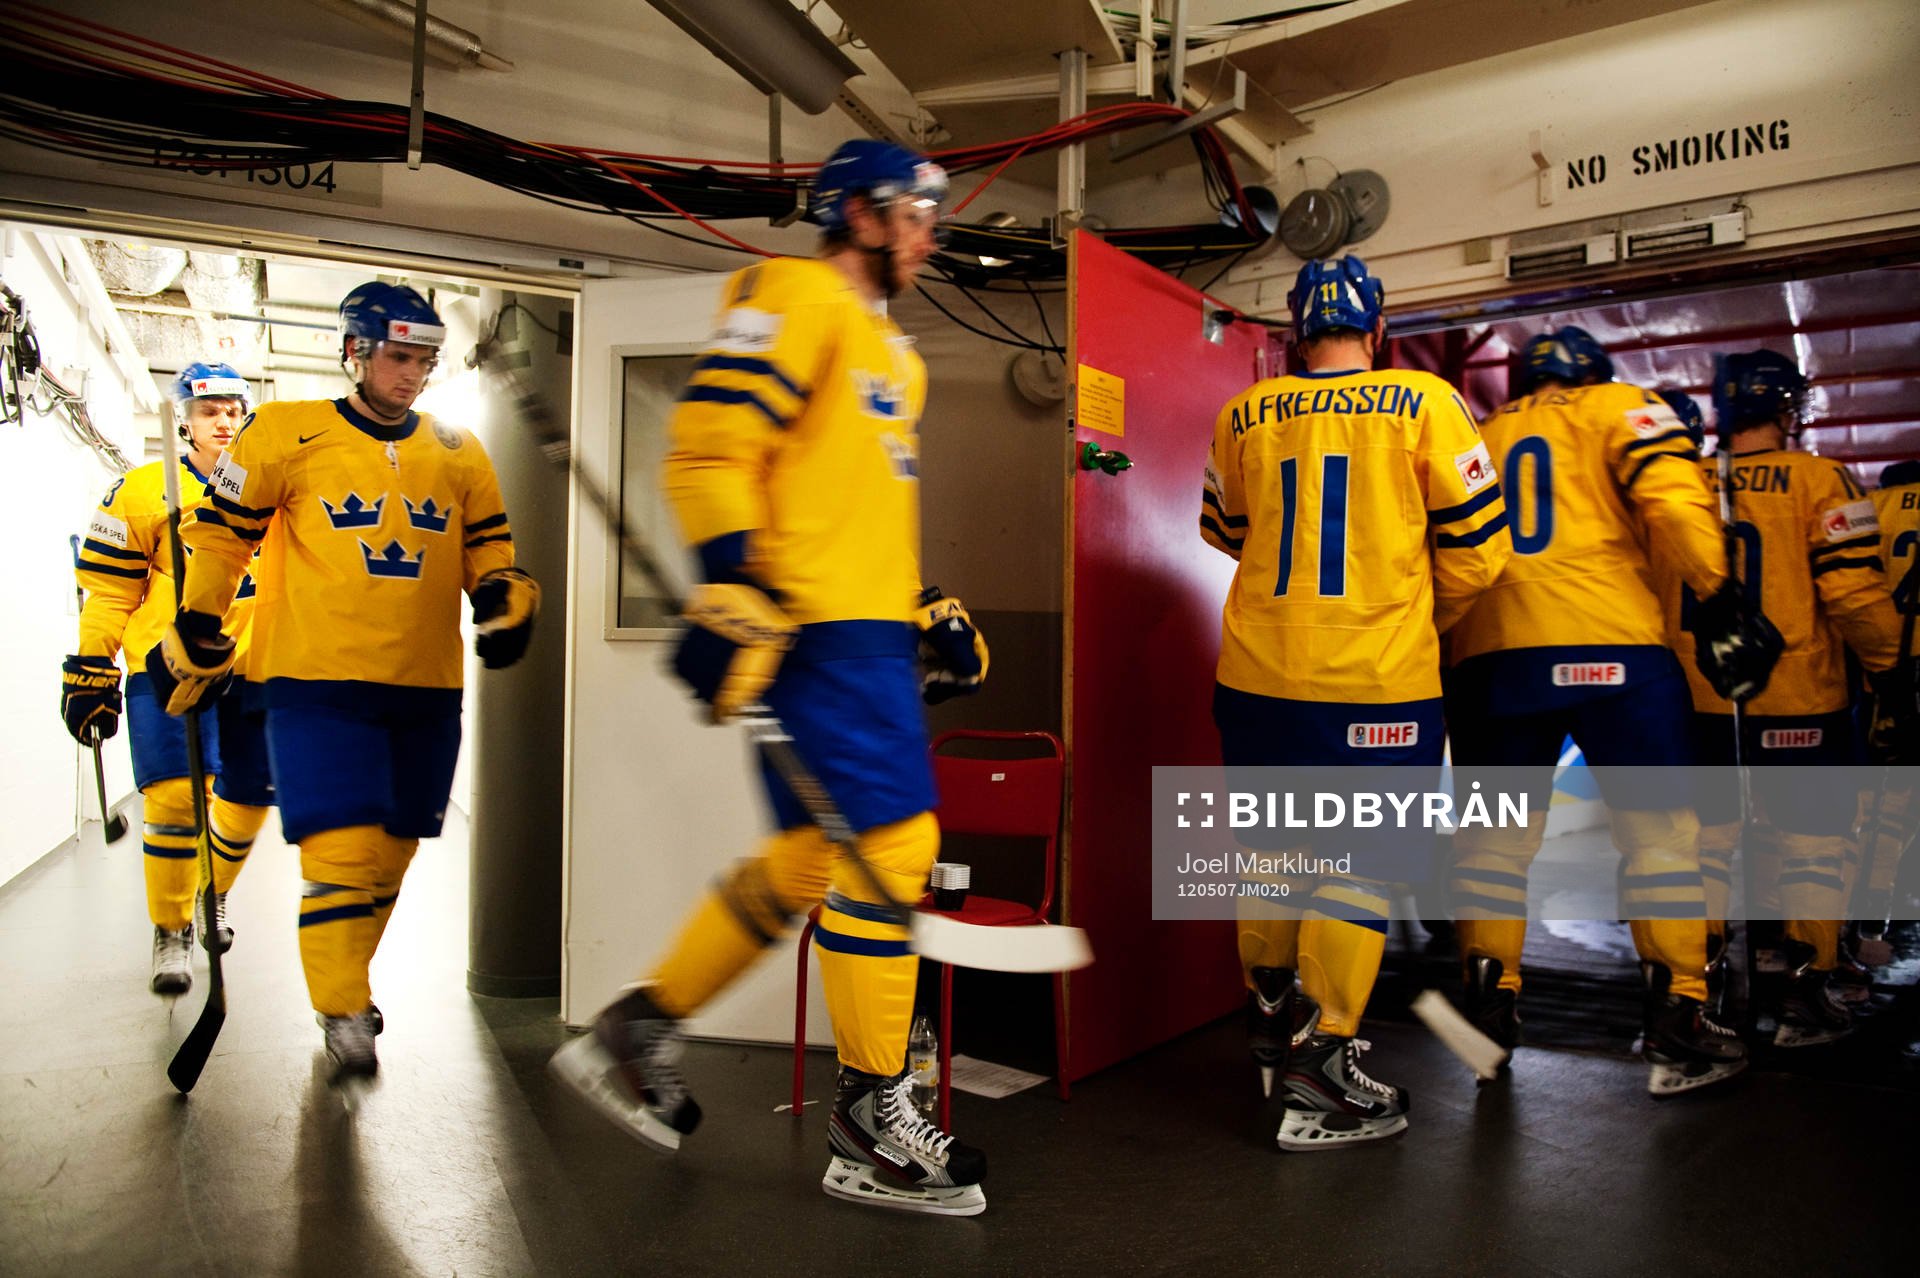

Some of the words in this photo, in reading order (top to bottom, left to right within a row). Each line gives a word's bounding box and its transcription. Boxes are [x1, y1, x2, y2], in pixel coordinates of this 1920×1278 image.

[1567, 154, 1607, 190] NO
[1632, 119, 1790, 176] SMOKING
[1320, 281, 1338, 302] 11
[1231, 384, 1424, 443] ALFREDSSON
[221, 477, 241, 495] SPEL
[1273, 454, 1349, 597] 11
[1572, 665, 1619, 683] IIHF
[1369, 725, 1414, 745] IIHF
[1778, 730, 1821, 746] IIHF
